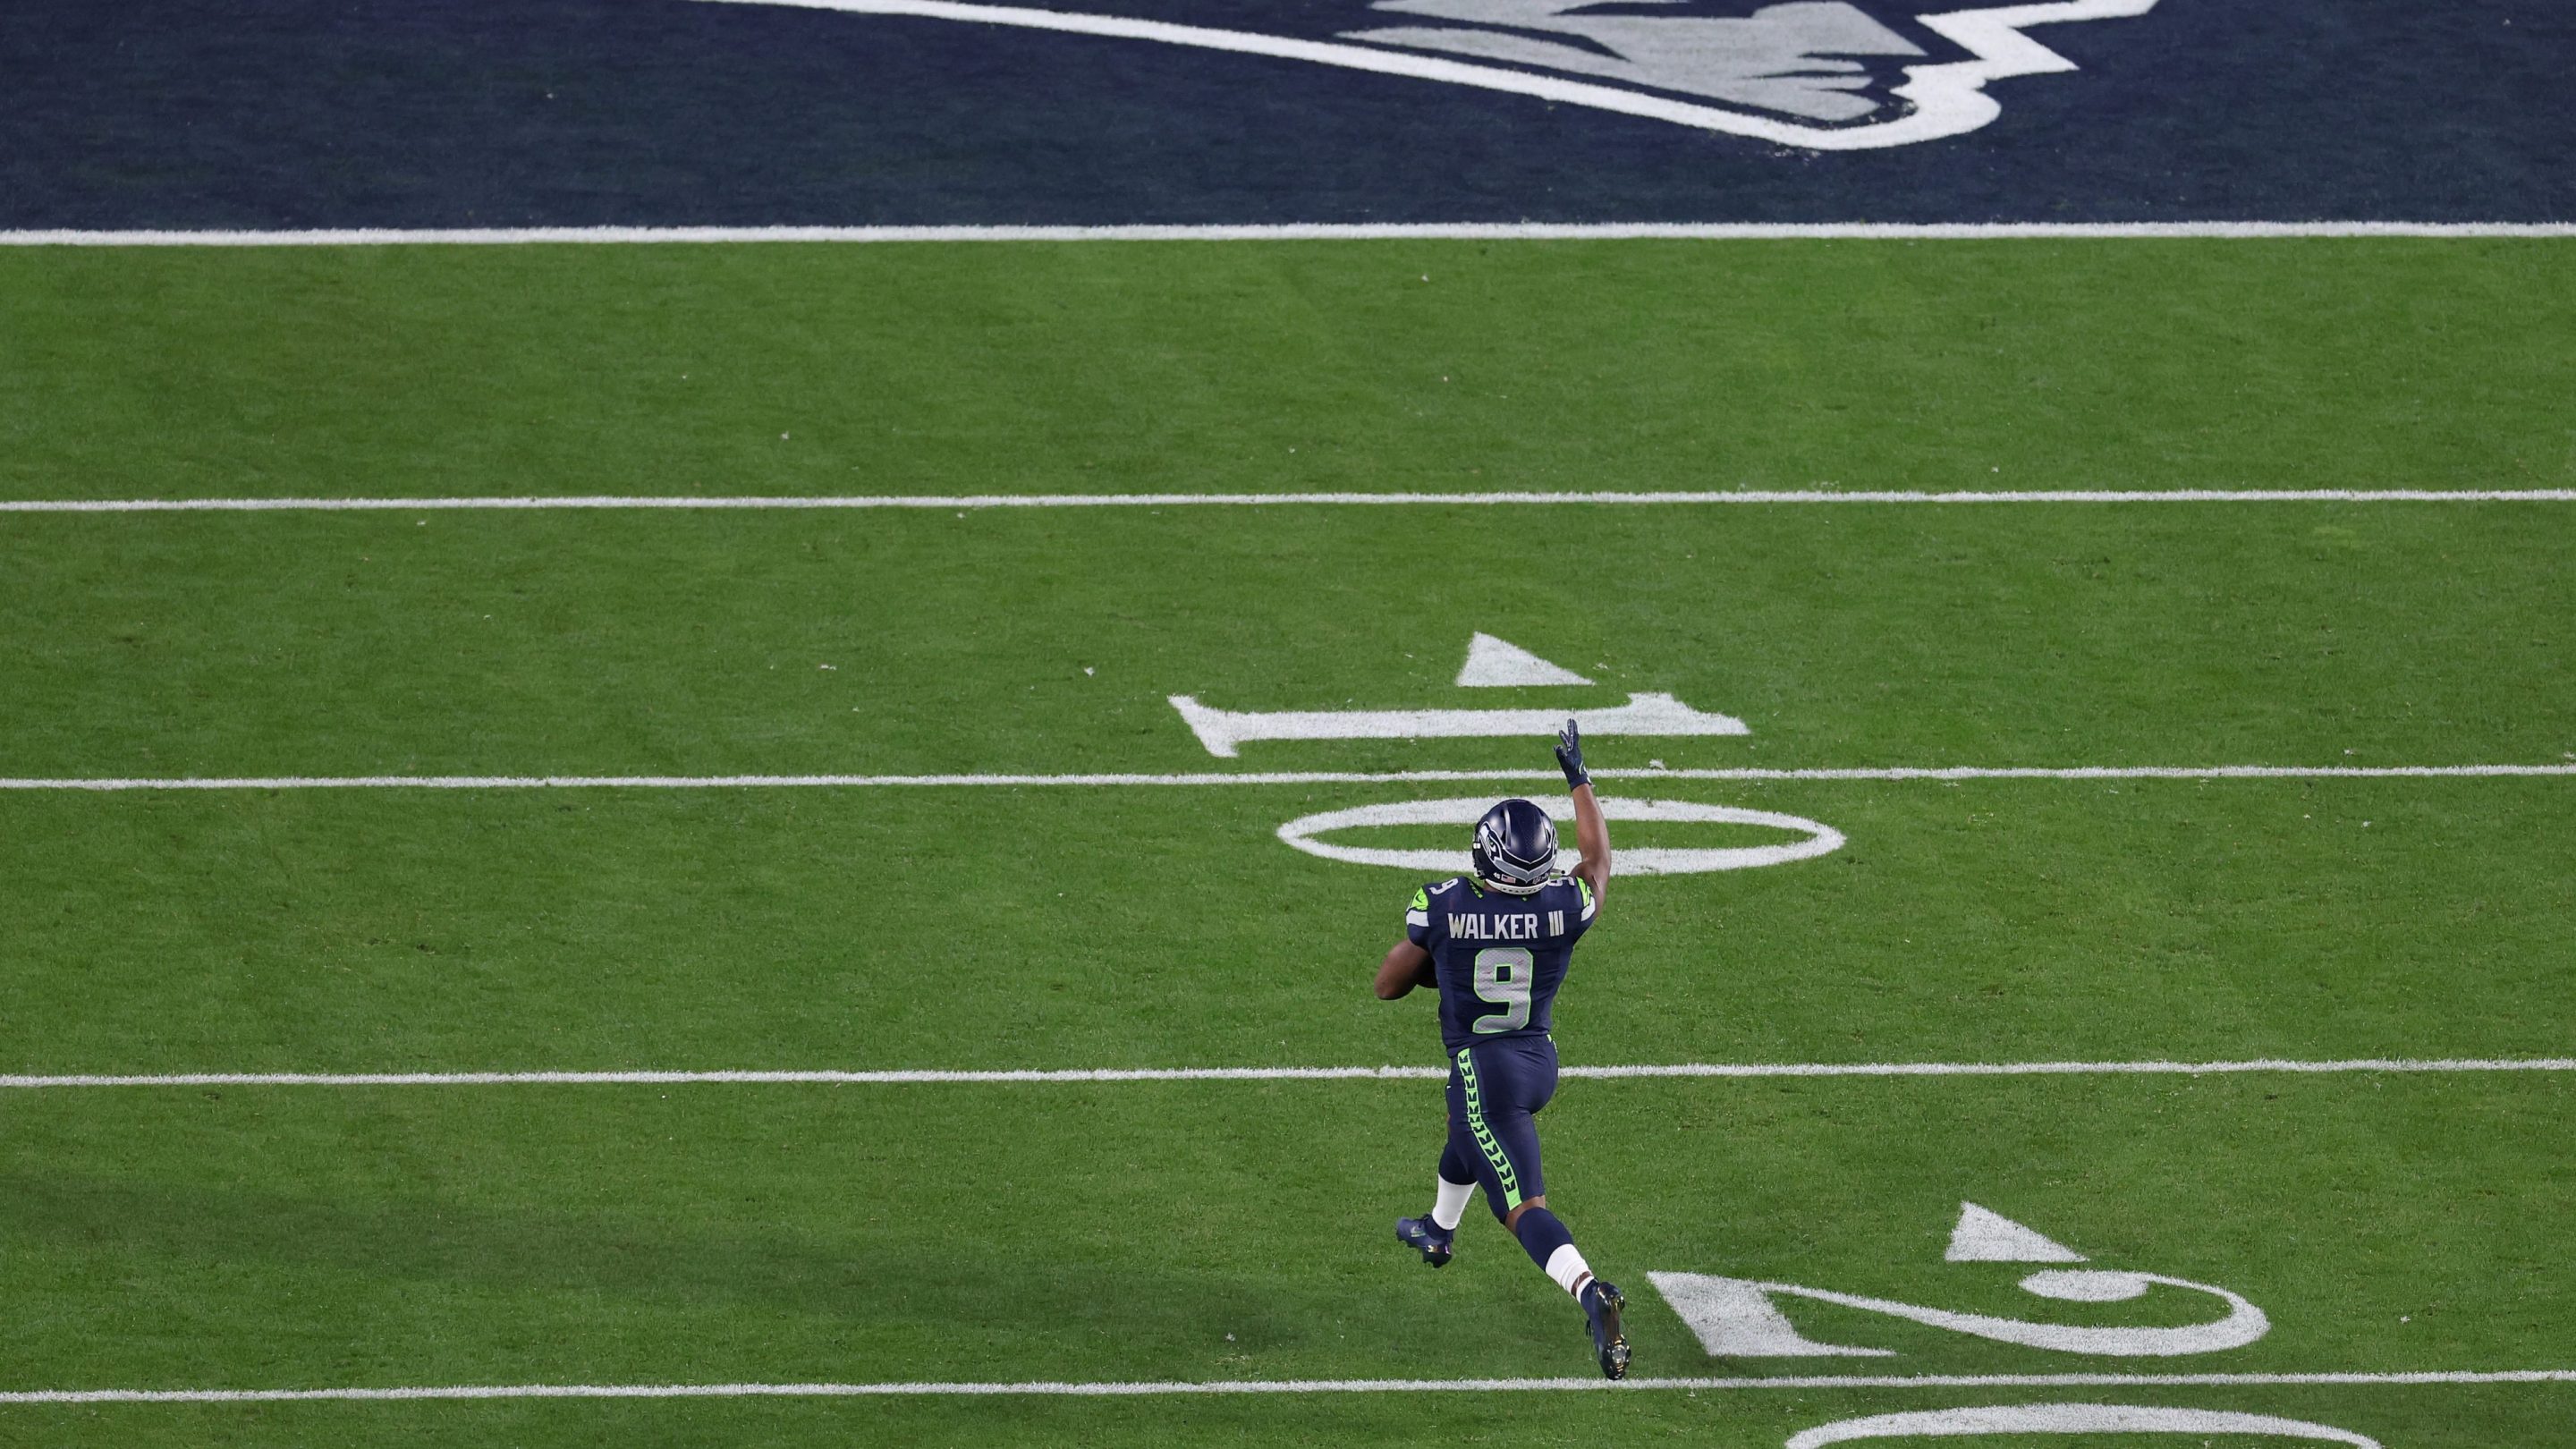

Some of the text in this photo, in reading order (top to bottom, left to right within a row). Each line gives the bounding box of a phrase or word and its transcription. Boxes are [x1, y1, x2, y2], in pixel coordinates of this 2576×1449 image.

[1166, 691, 1848, 875] 10
[1428, 877, 1459, 895] 9
[1447, 910, 1564, 940] WALKER III
[1472, 946, 1533, 1034] 9
